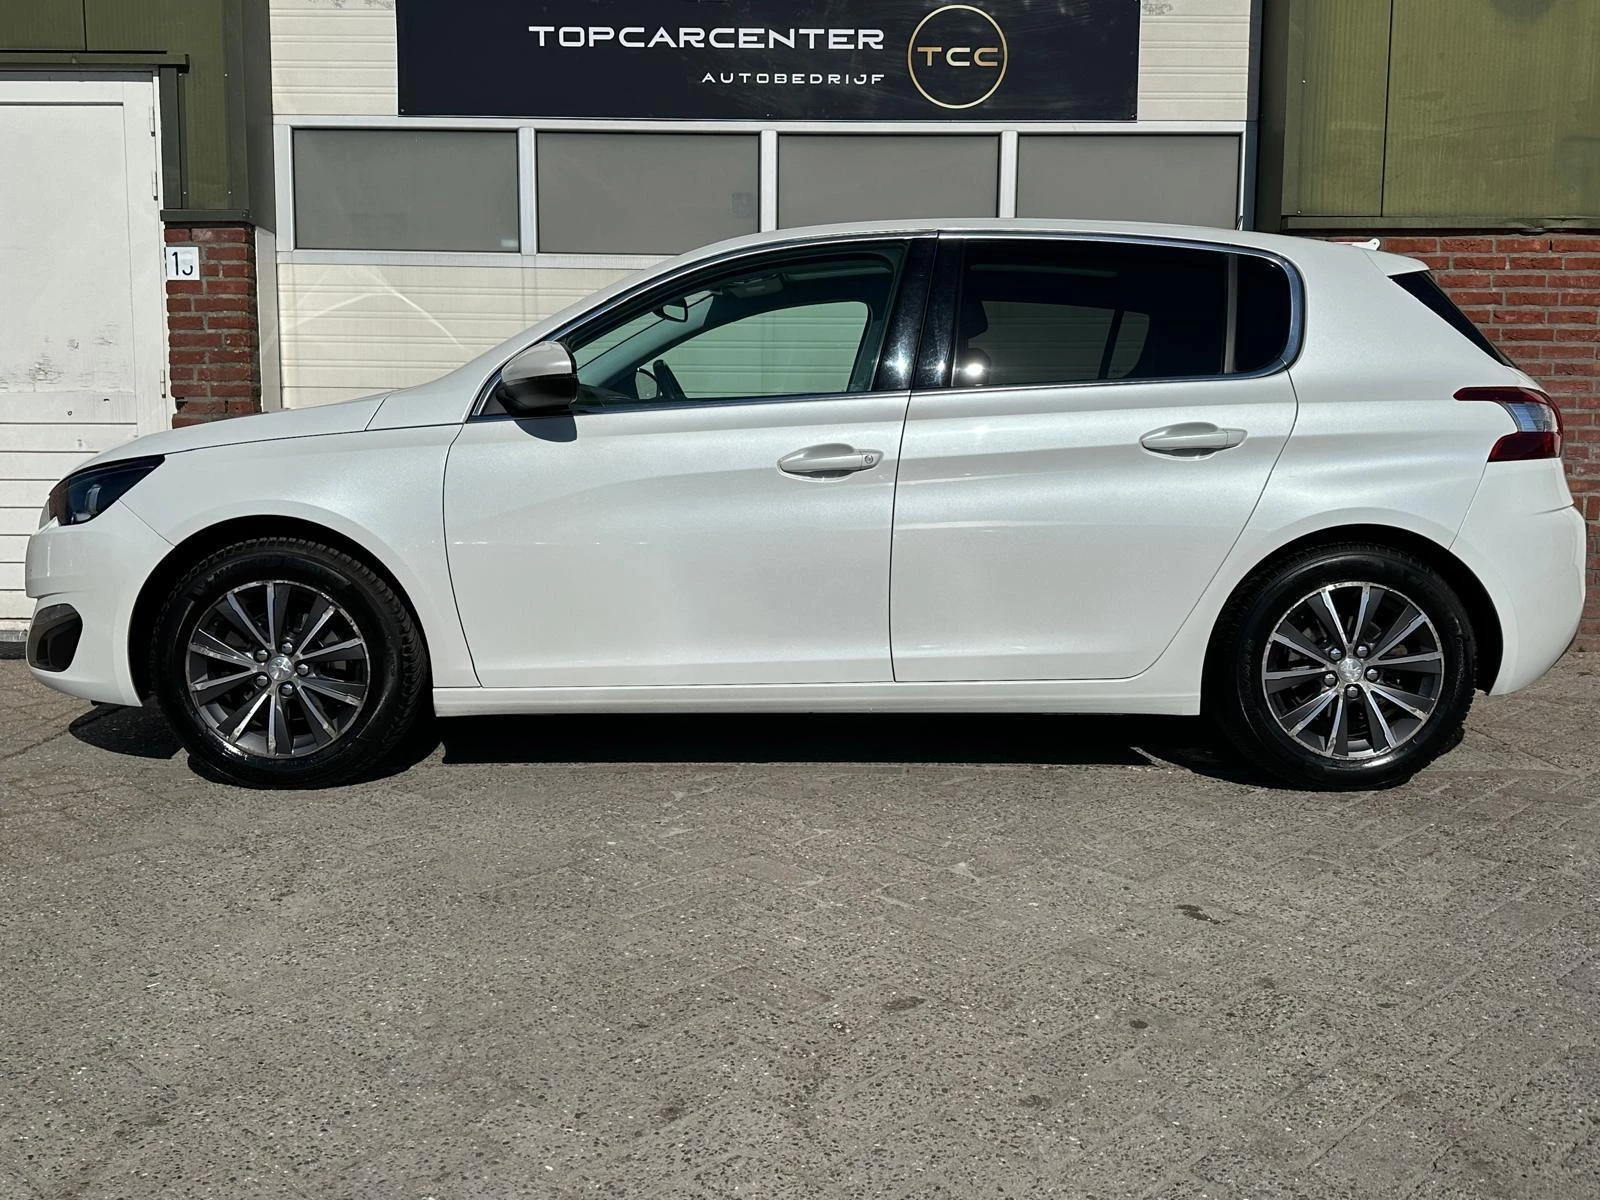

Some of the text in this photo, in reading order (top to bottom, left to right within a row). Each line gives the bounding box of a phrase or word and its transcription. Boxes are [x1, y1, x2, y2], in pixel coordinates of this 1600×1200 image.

[528, 25, 885, 50] TOPCARCENTER
[917, 46, 999, 67] TCC
[701, 72, 885, 85] AUTOBEDRIJF
